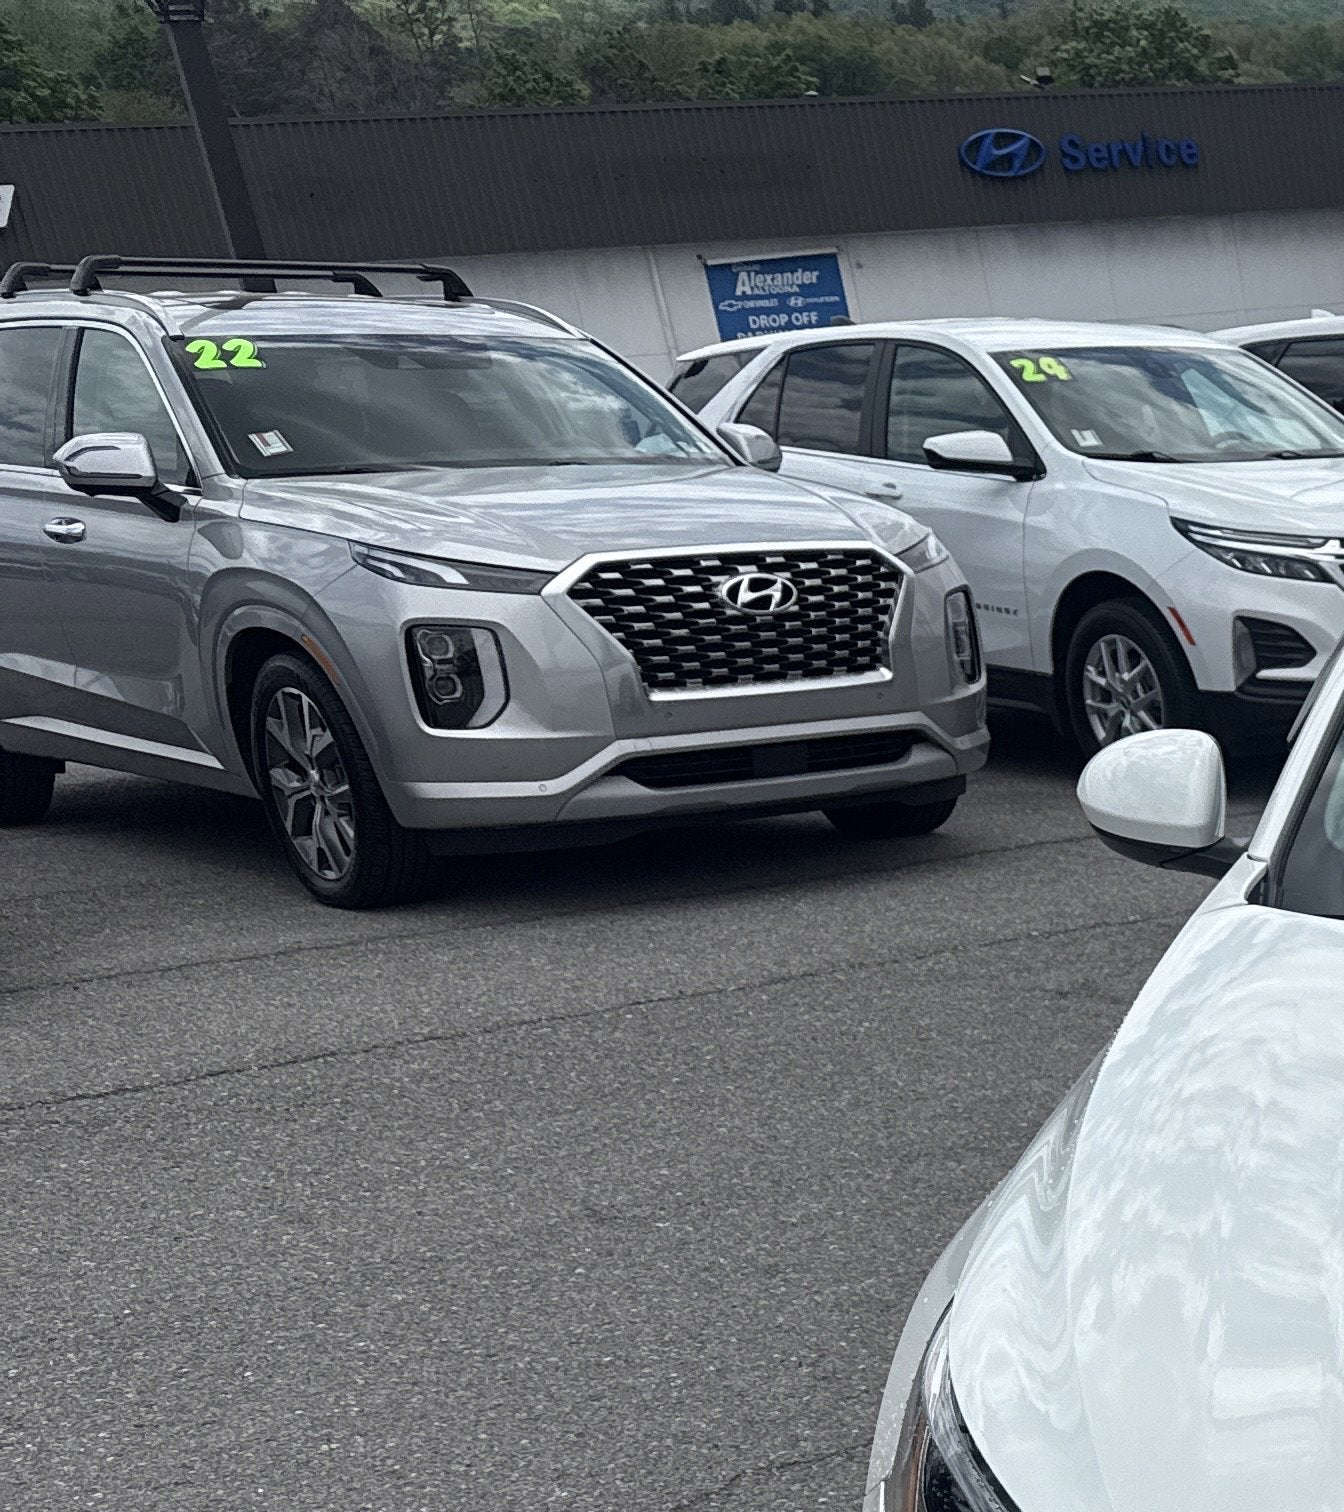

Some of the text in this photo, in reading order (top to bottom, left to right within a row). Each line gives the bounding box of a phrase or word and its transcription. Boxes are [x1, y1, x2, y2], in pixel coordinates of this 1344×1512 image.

[1059, 130, 1200, 171] Service
[735, 267, 820, 296] Alexander
[748, 311, 819, 329] DROP OFF
[185, 338, 265, 370] 22
